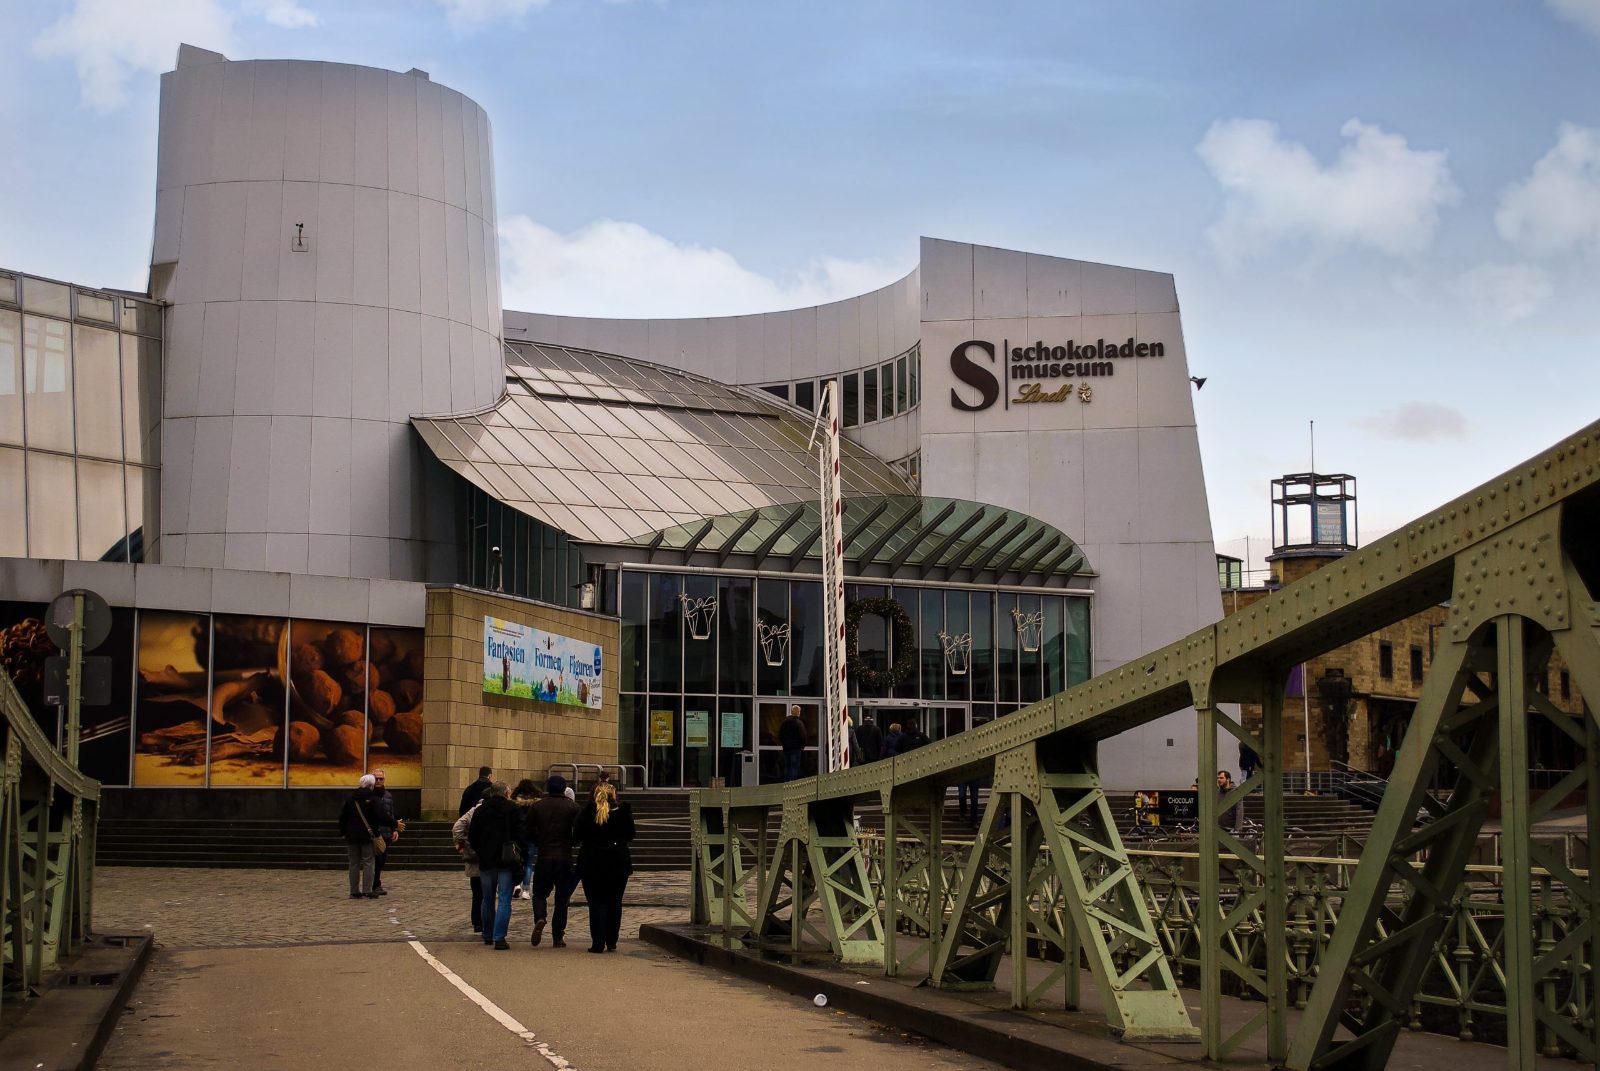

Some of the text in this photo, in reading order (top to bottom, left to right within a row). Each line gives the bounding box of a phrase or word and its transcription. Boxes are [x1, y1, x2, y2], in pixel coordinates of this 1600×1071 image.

[1011, 337, 1165, 361] schokoladen
[950, 340, 1000, 412] S
[1011, 361, 1114, 379] museum
[1012, 383, 1073, 404] Lindt
[487, 636, 525, 664] Fantasien
[569, 654, 594, 680] Figuren
[1167, 796, 1194, 804] CHOCOLAT
